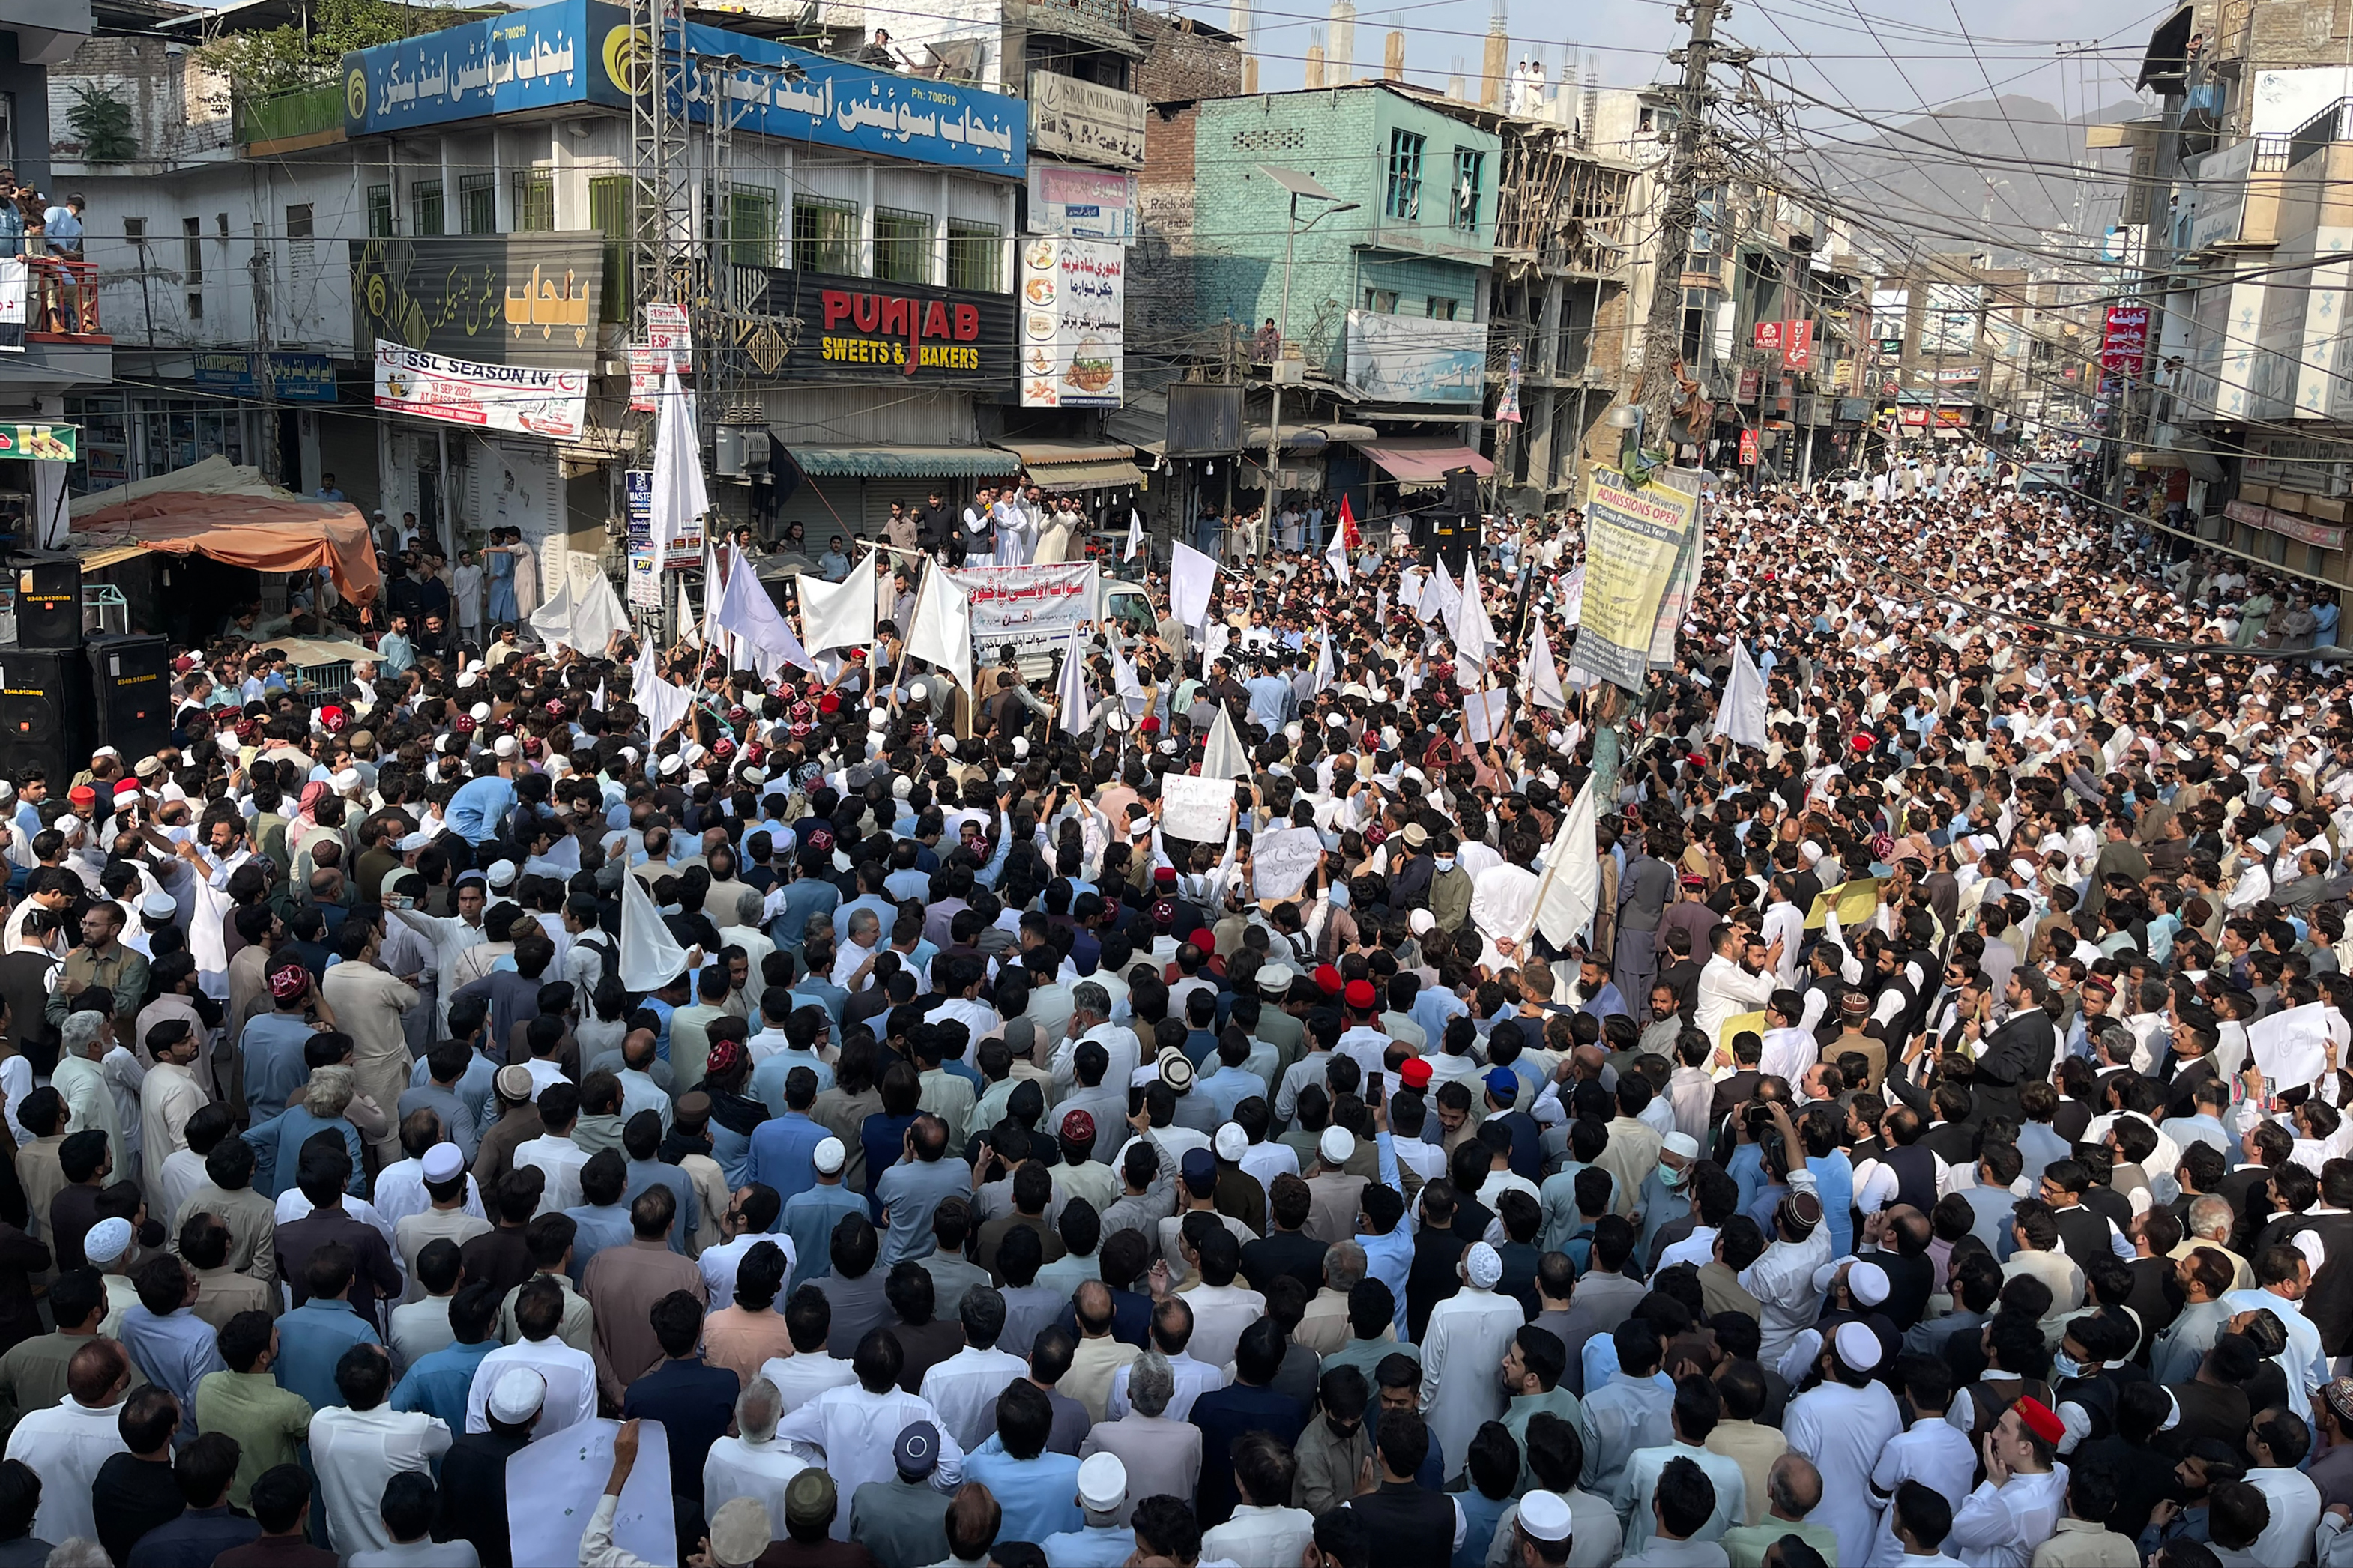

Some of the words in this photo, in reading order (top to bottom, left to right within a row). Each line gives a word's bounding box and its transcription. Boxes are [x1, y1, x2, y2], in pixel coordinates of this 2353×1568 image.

[505, 25, 527, 40] 700219
[516, 30, 575, 89] پنجاب
[377, 61, 417, 116] بیکرز
[911, 88, 926, 100] Ph:
[927, 91, 958, 106] 700219
[1063, 84, 1086, 105] ISRAR
[1087, 90, 1145, 119] INTERNATIONAL
[939, 105, 1012, 165] پنجاب
[1151, 197, 1176, 209] Rock
[2133, 157, 2148, 220] REURANT
[504, 264, 590, 349] پنجاب
[821, 289, 979, 375] PUNJAB
[1793, 321, 1804, 348] BUTT
[205, 354, 248, 373] ENTERPRISES
[822, 336, 889, 364] SWEETS
[893, 342, 905, 365] &
[920, 345, 979, 370] BAKERS
[406, 352, 442, 370] SSL
[447, 360, 525, 384] SEASON
[531, 371, 552, 386] IV
[420, 392, 429, 402] AT
[429, 393, 456, 405] GRASSY
[440, 384, 453, 394] SEP
[454, 386, 472, 397] 2022
[629, 491, 651, 502] MASTE
[1597, 488, 1652, 516] ADMISSIONS
[1652, 508, 1679, 524] OPEN
[1624, 484, 1647, 500] Virtual
[1649, 491, 1685, 517] University
[1597, 506, 1616, 521] Diploma
[1616, 514, 1644, 531] Programs
[1651, 527, 1668, 539] Year)
[1612, 528, 1649, 546] Psychology
[1616, 541, 1650, 557] Production
[637, 560, 650, 569] DIT
[1050, 579, 1084, 599] سوات
[1002, 609, 1033, 628] امن
[1578, 627, 1594, 638] Tech
[1616, 647, 1643, 662] Institute
